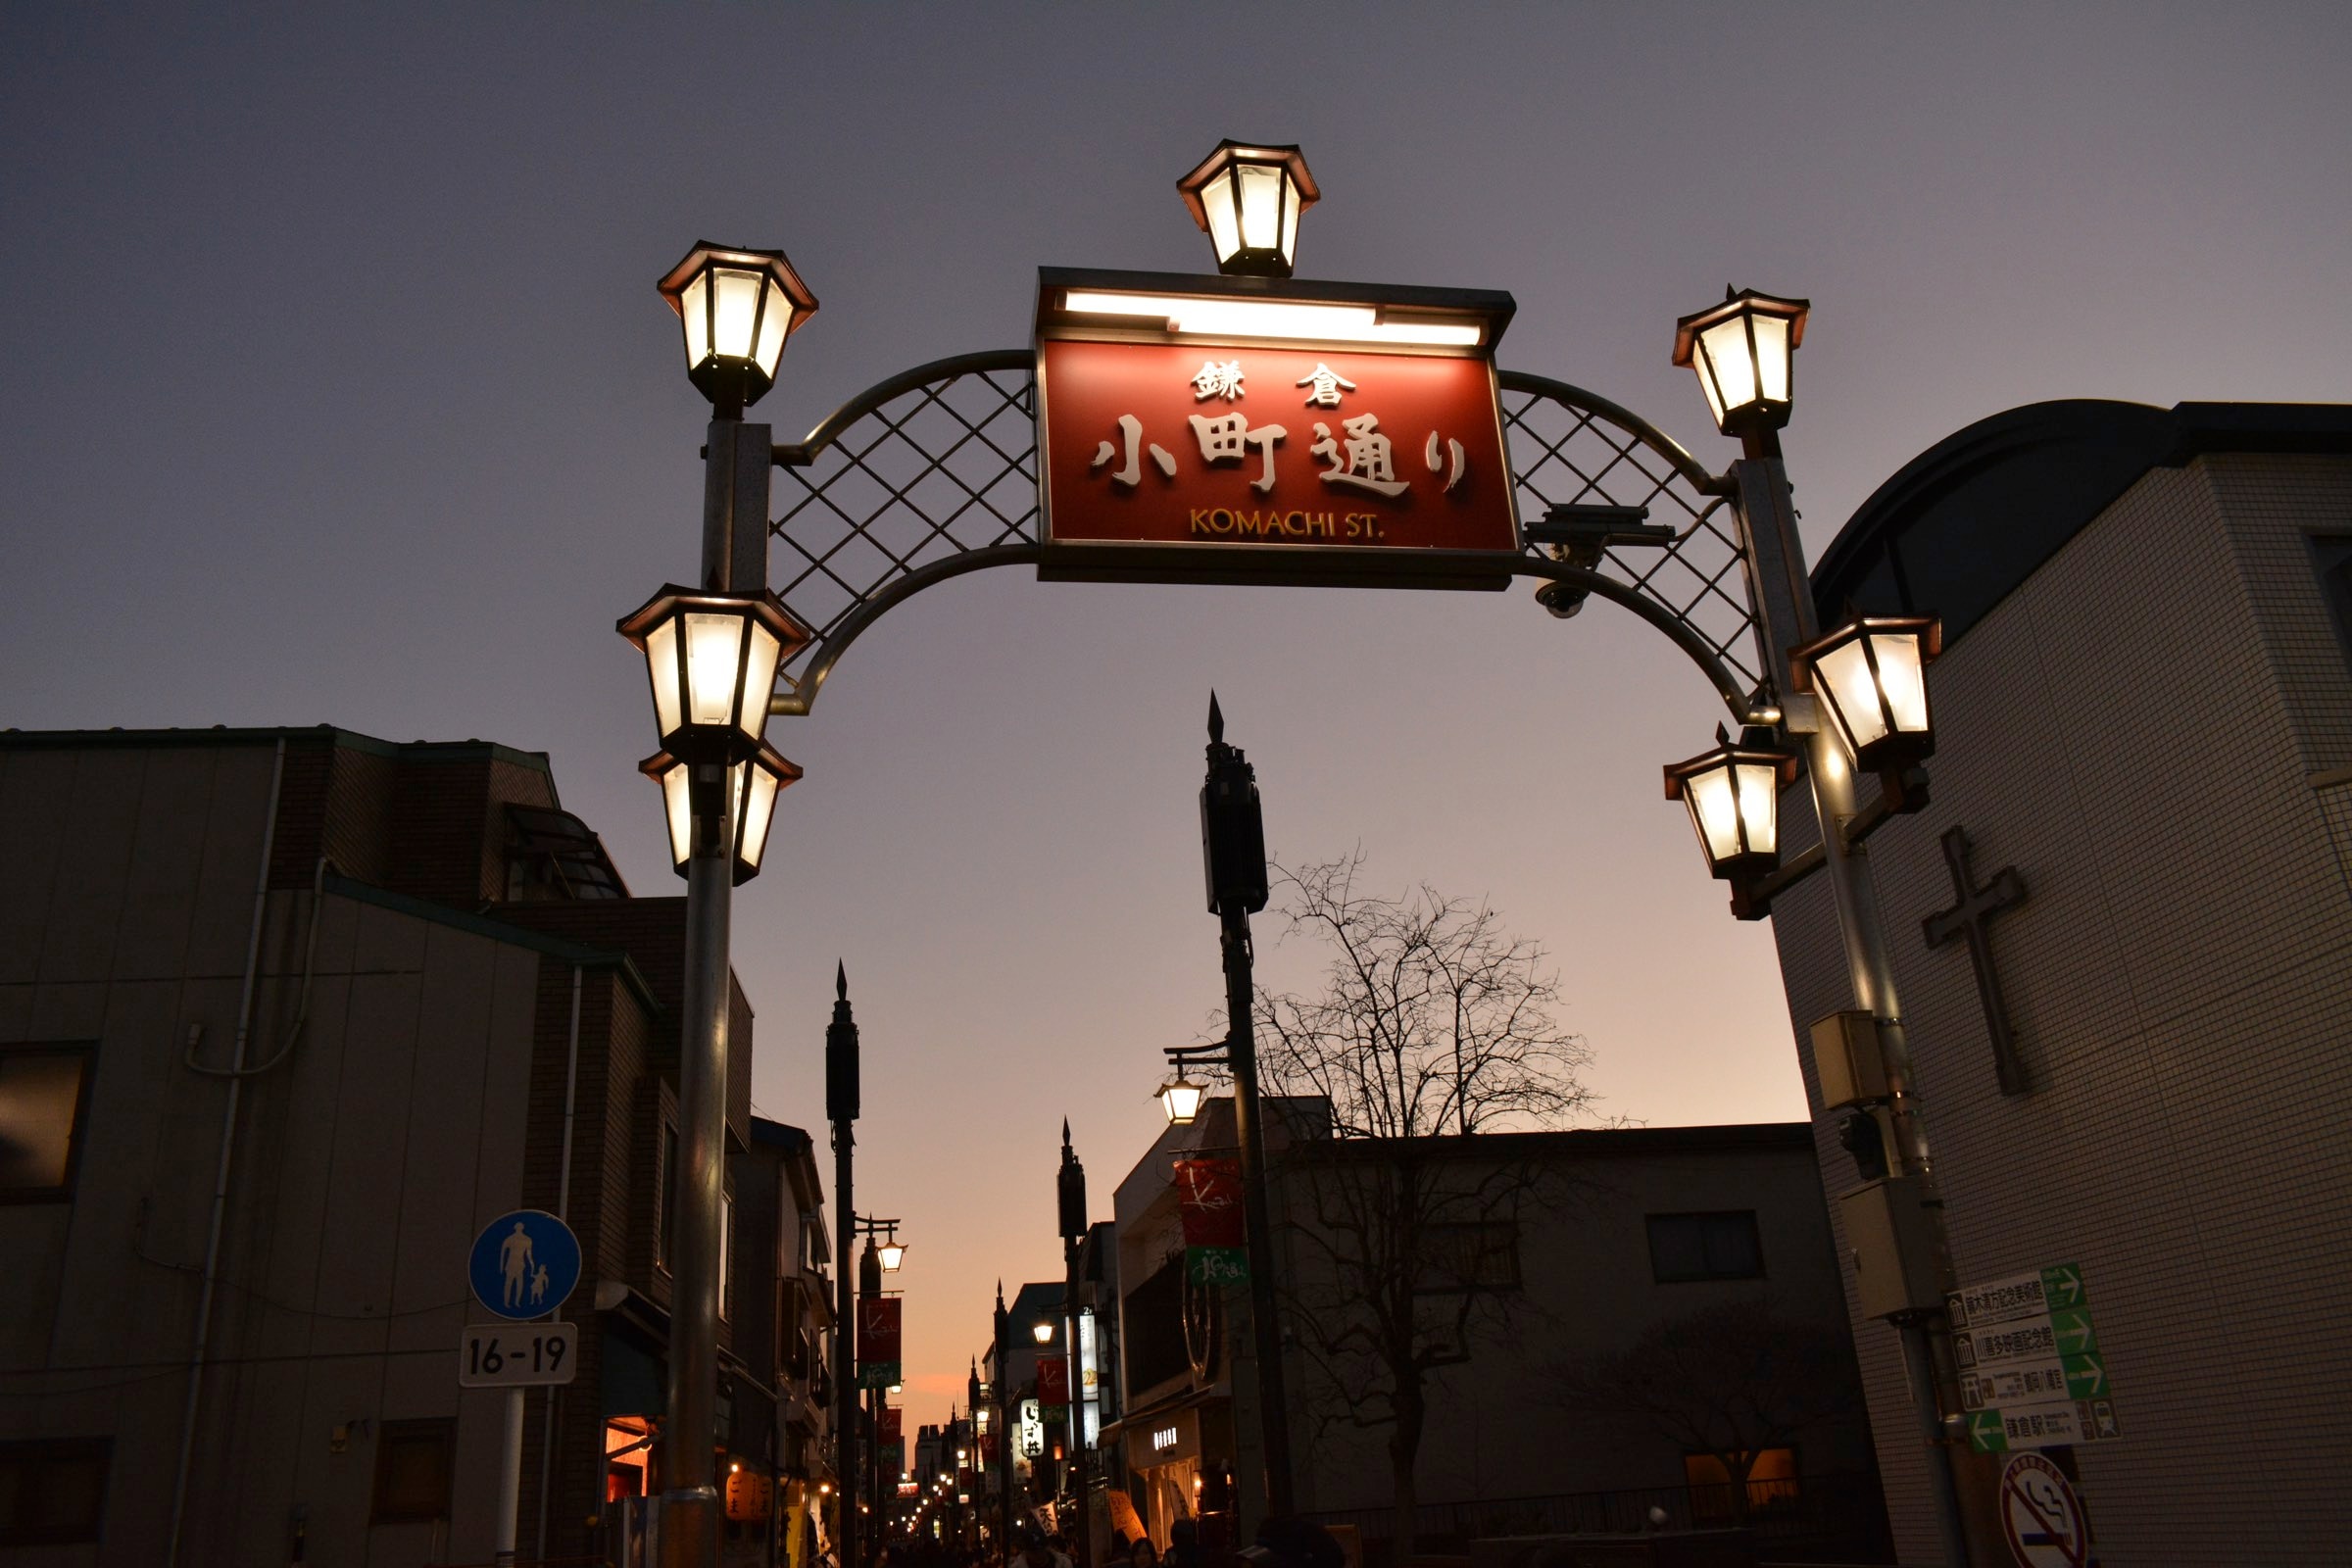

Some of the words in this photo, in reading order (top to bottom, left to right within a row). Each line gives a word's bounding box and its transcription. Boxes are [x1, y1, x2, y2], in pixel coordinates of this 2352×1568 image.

[1190, 360, 1356, 408] 鎌倉
[1090, 411, 1465, 498] 小町通り
[1190, 508, 1336, 538] KOMACHI
[1346, 512, 1385, 538] ST.
[470, 1336, 565, 1374] 16-19
